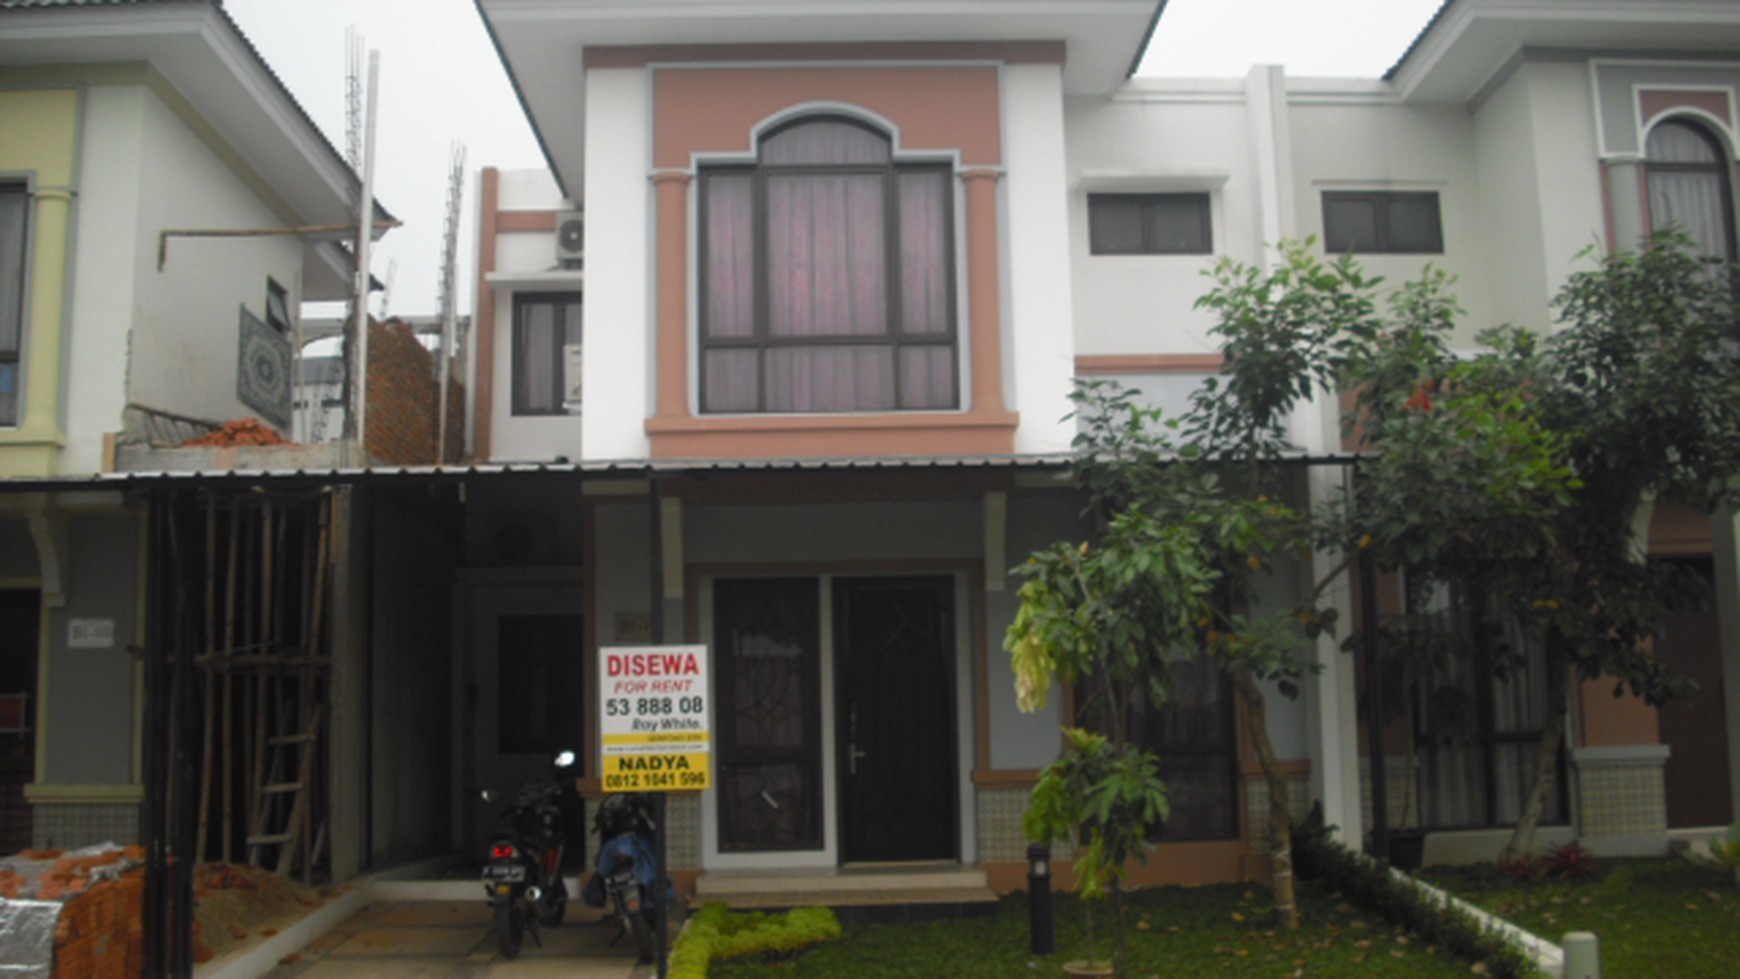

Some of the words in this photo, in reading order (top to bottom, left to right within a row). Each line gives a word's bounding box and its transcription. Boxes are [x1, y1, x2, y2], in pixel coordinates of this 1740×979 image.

[607, 654, 700, 677] DISEWA
[614, 680, 647, 694] FOR
[651, 679, 693, 693] RENT
[606, 698, 630, 716] 53
[637, 697, 673, 715] 888
[679, 695, 703, 714] 08
[619, 755, 690, 772] NADYA
[605, 774, 640, 788] 0812
